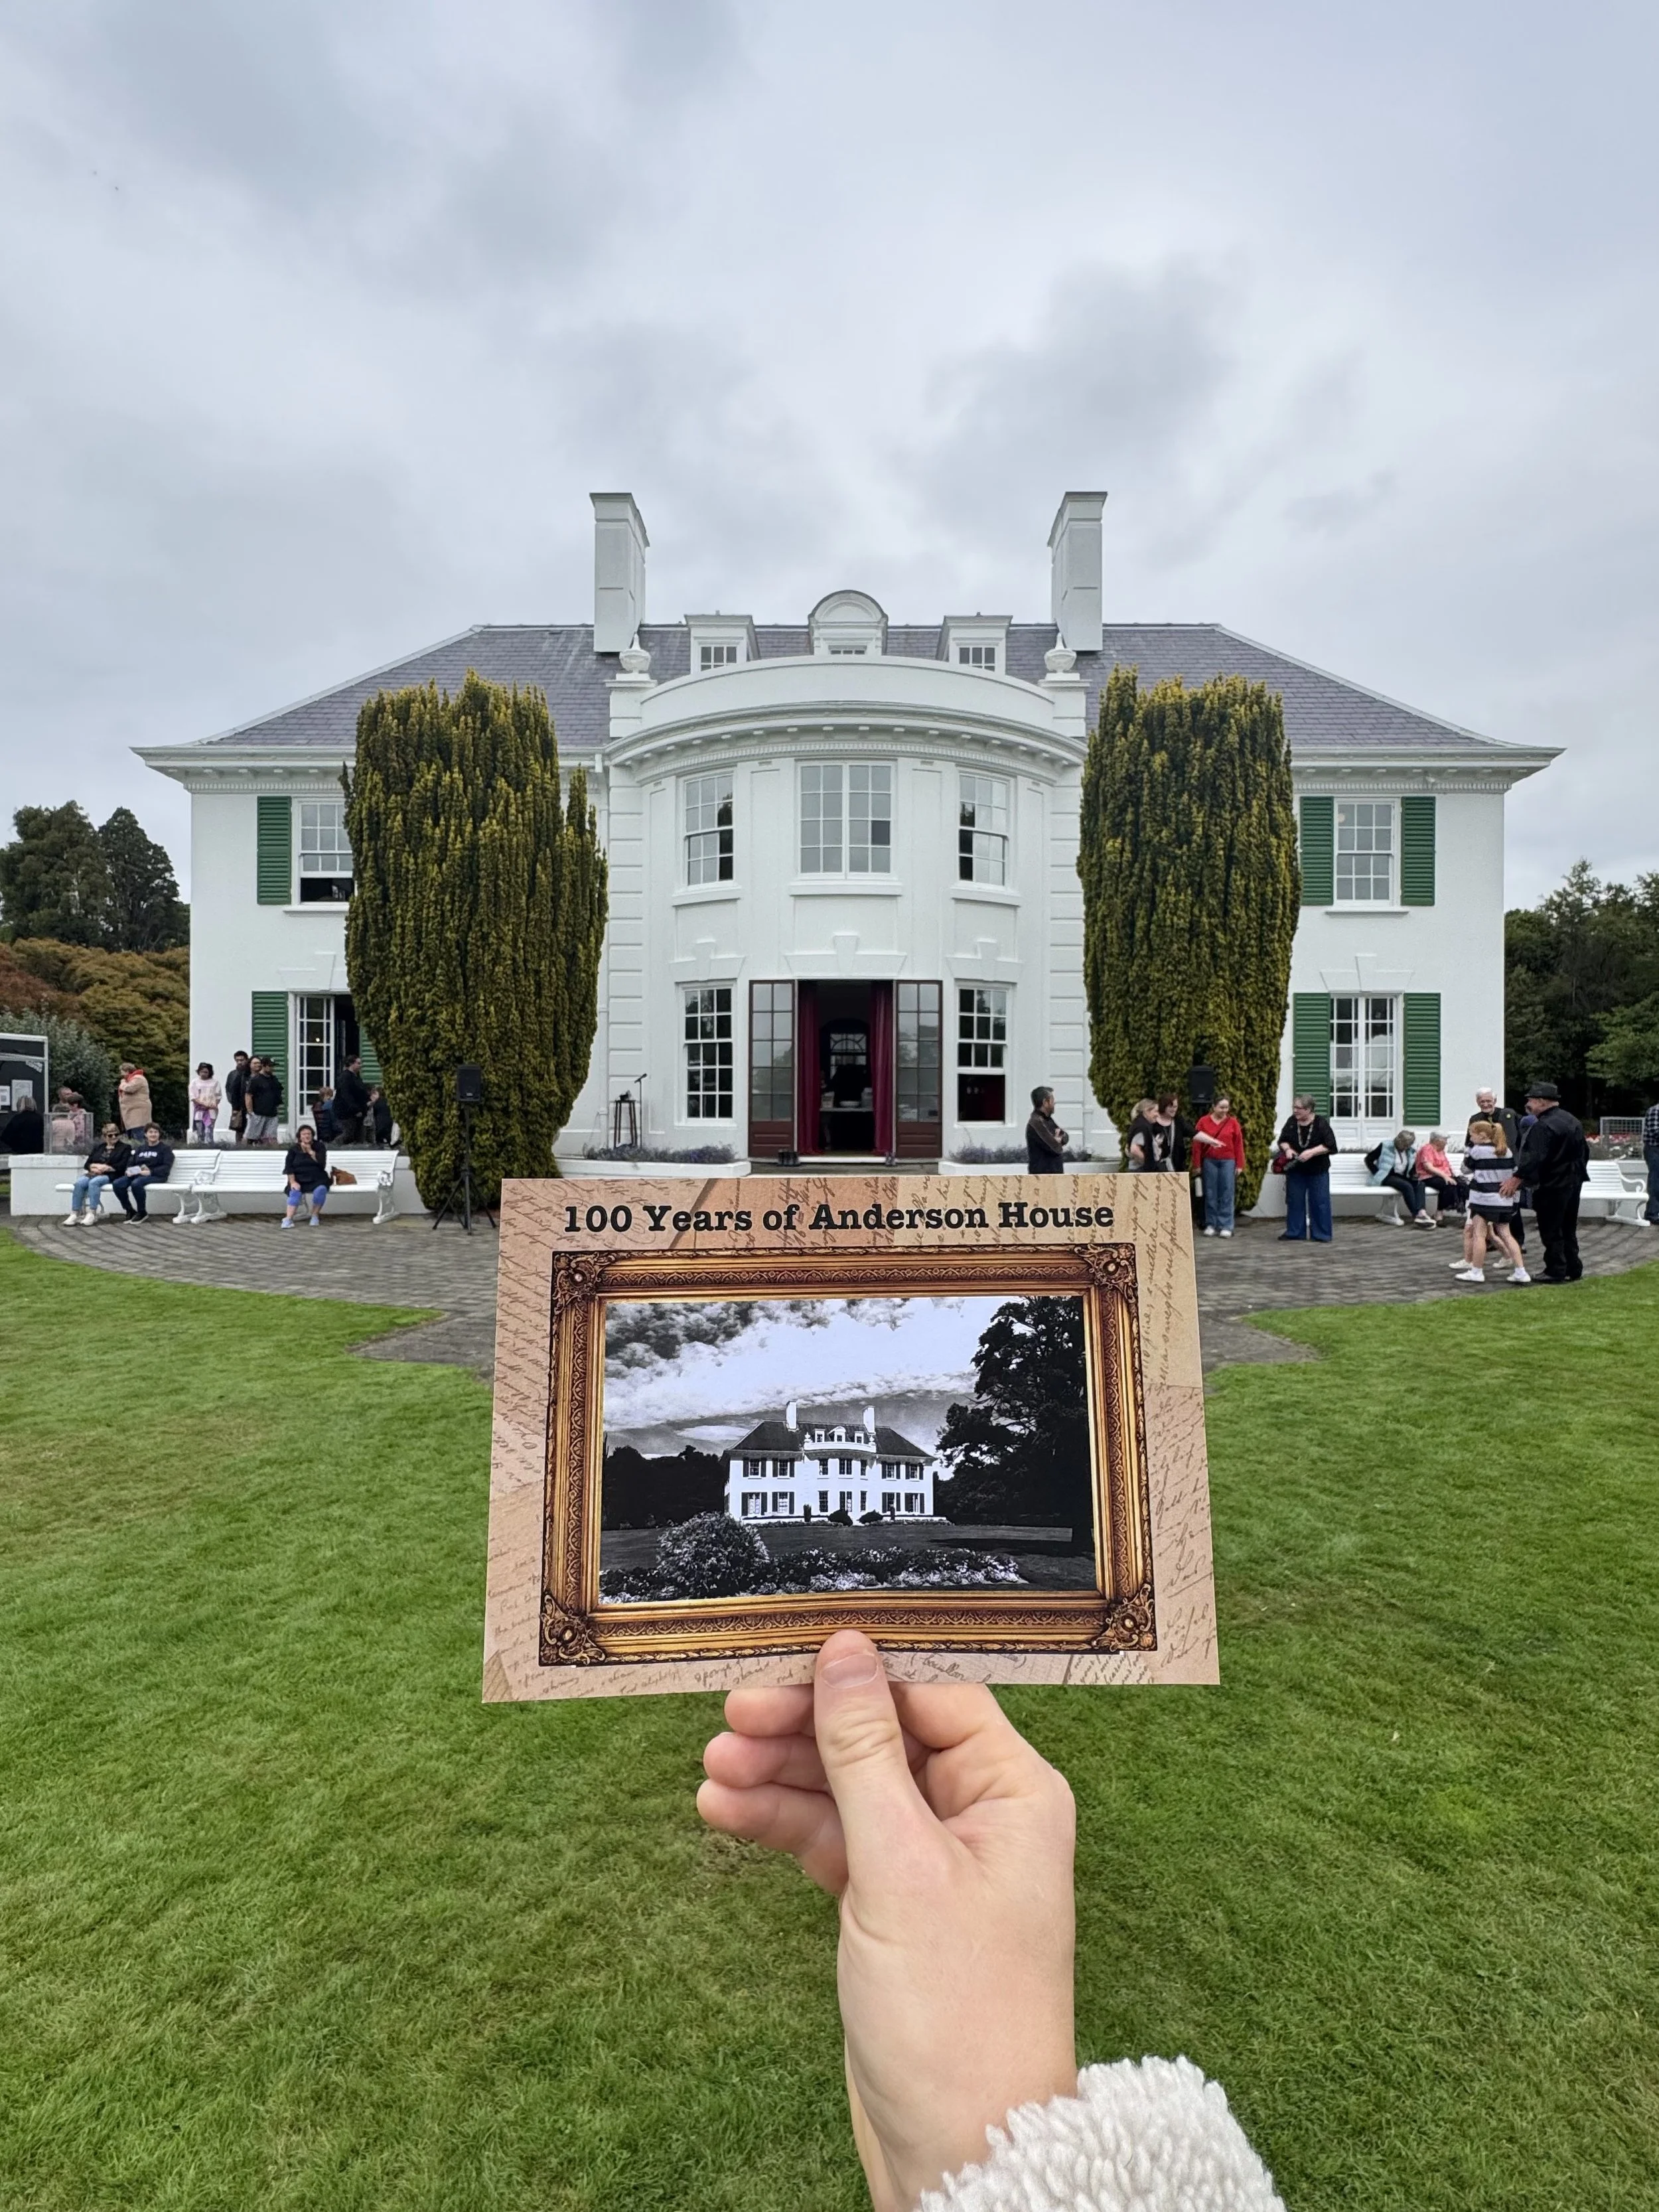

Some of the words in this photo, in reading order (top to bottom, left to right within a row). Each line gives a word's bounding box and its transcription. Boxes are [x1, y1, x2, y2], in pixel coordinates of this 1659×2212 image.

[565, 1205, 632, 1232] 100
[642, 1205, 753, 1232] Years
[762, 1204, 800, 1231] of
[808, 1203, 989, 1230] Anderson
[997, 1202, 1114, 1228] House
